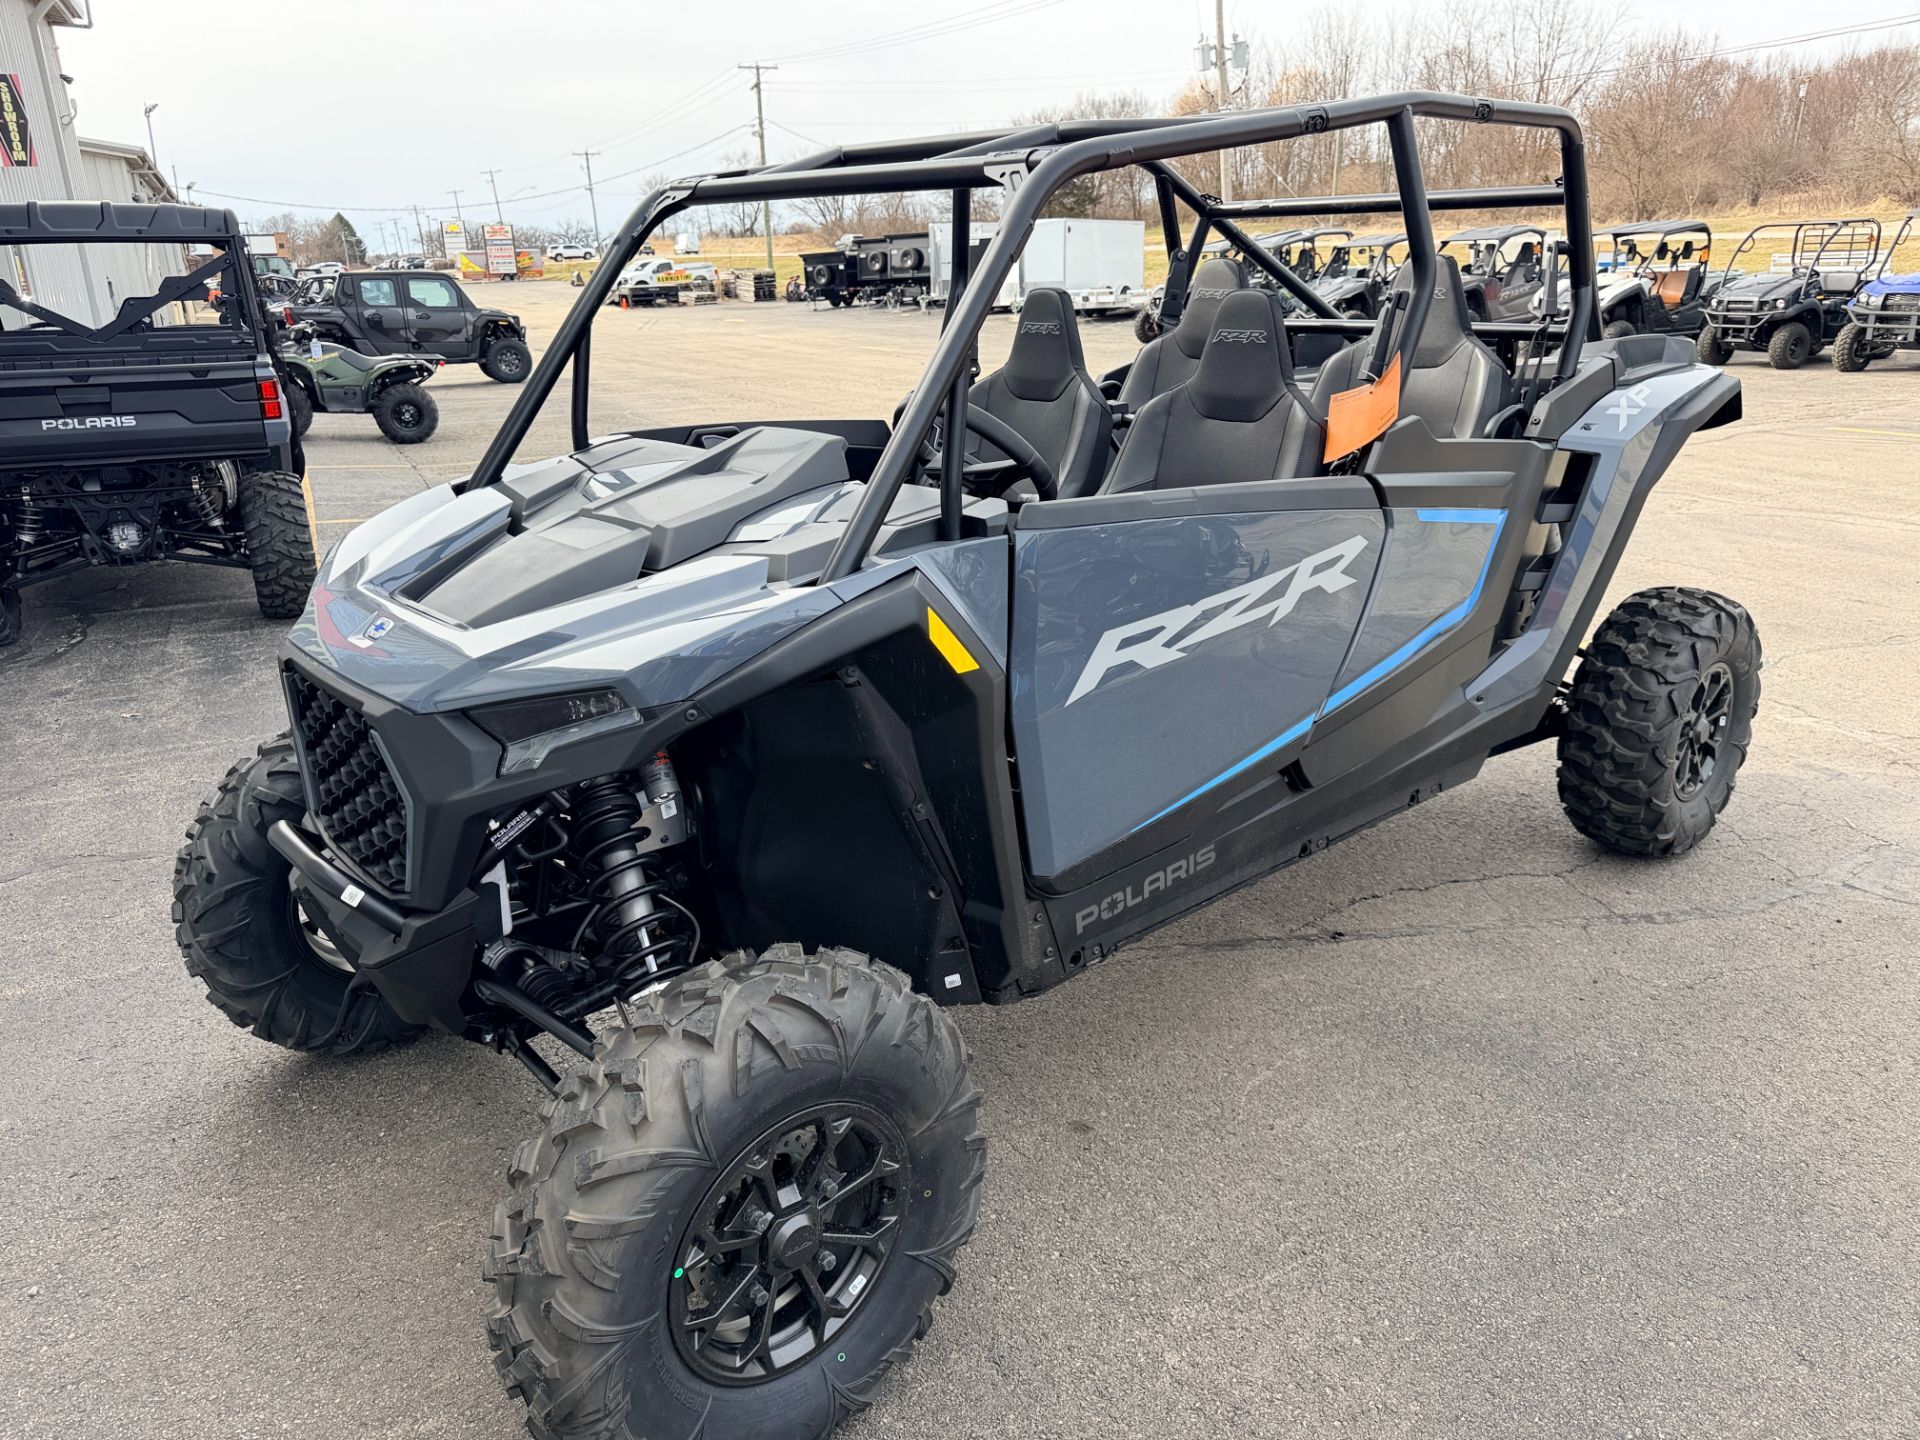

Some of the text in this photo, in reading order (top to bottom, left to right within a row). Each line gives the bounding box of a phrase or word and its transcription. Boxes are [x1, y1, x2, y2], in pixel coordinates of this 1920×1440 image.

[0, 81, 28, 161] SHOWROOM
[1020, 321, 1060, 335] RZR
[1212, 329, 1267, 344] RZR
[41, 416, 137, 430] POLARIS
[1605, 383, 1653, 433] XP
[1063, 534, 1369, 708] RZR
[490, 810, 528, 842] POLARIS
[1075, 843, 1217, 936] POLARIS
